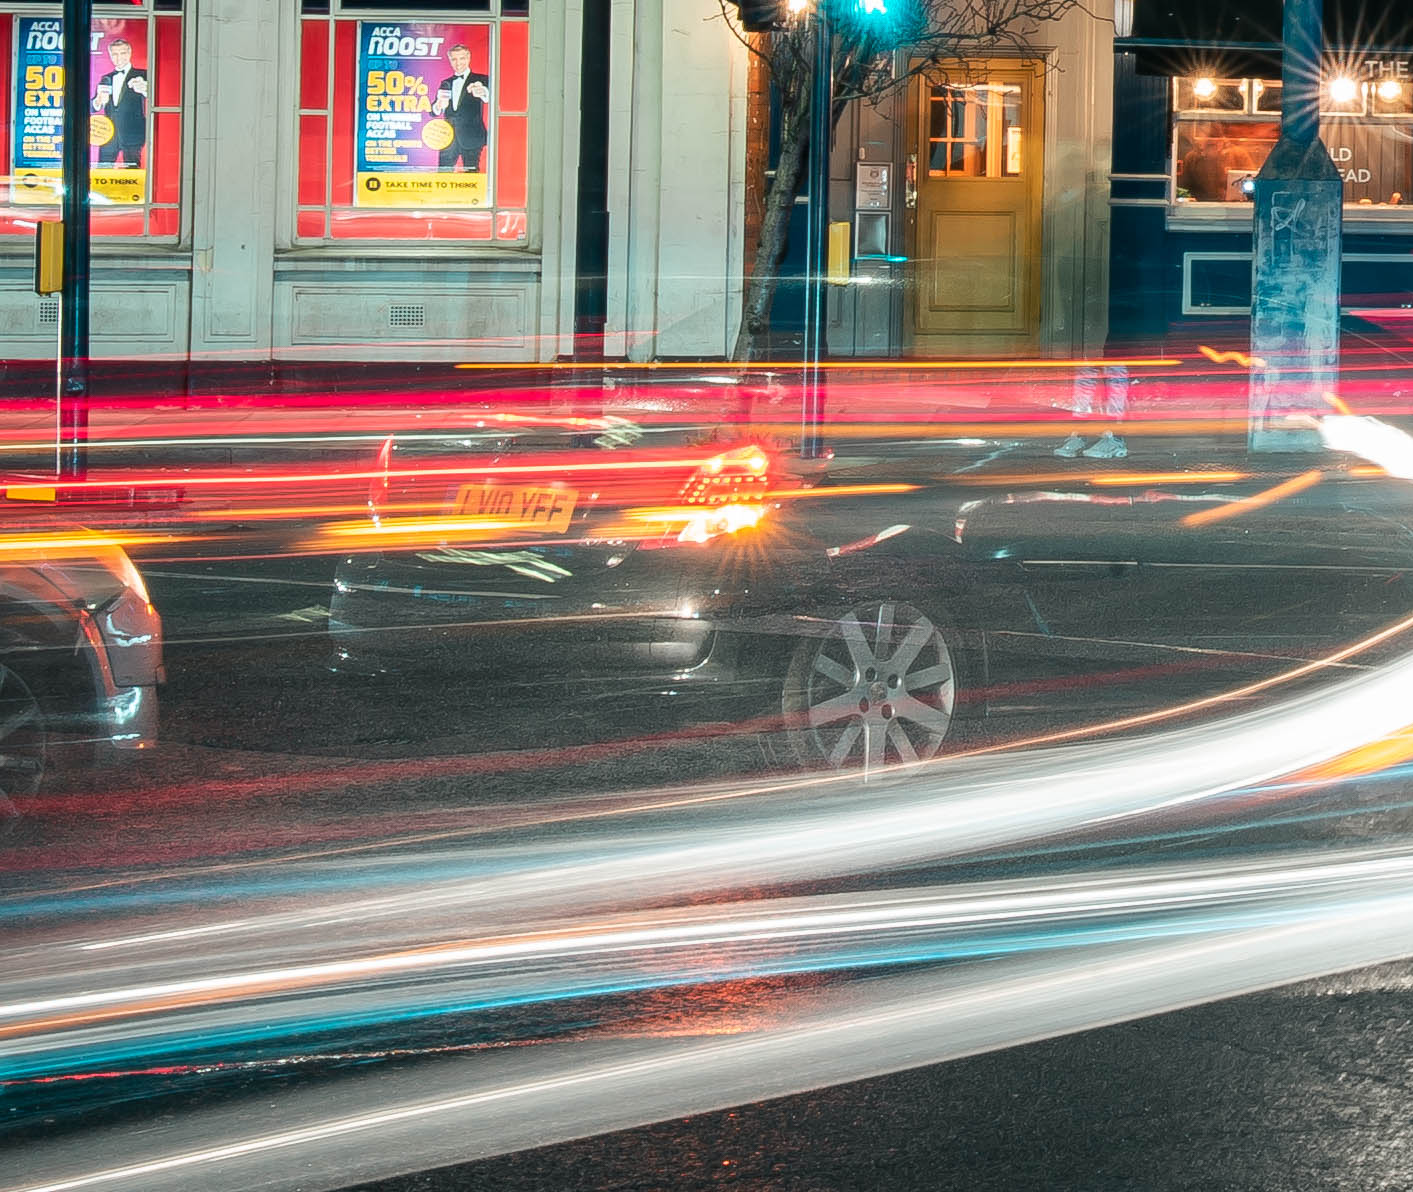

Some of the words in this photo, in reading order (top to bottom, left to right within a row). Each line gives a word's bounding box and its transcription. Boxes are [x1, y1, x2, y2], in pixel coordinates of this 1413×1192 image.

[30, 21, 60, 31] ACCA
[371, 26, 401, 37] ACCA
[25, 66, 65, 90] 50
[1364, 60, 1409, 79] THE
[367, 70, 429, 96] 50%
[24, 90, 64, 107] EXT
[366, 95, 432, 113] EXTRA
[385, 181, 409, 189] TAKE
[411, 181, 433, 189] TIME
[436, 181, 448, 189] TO
[450, 181, 478, 189] THINK
